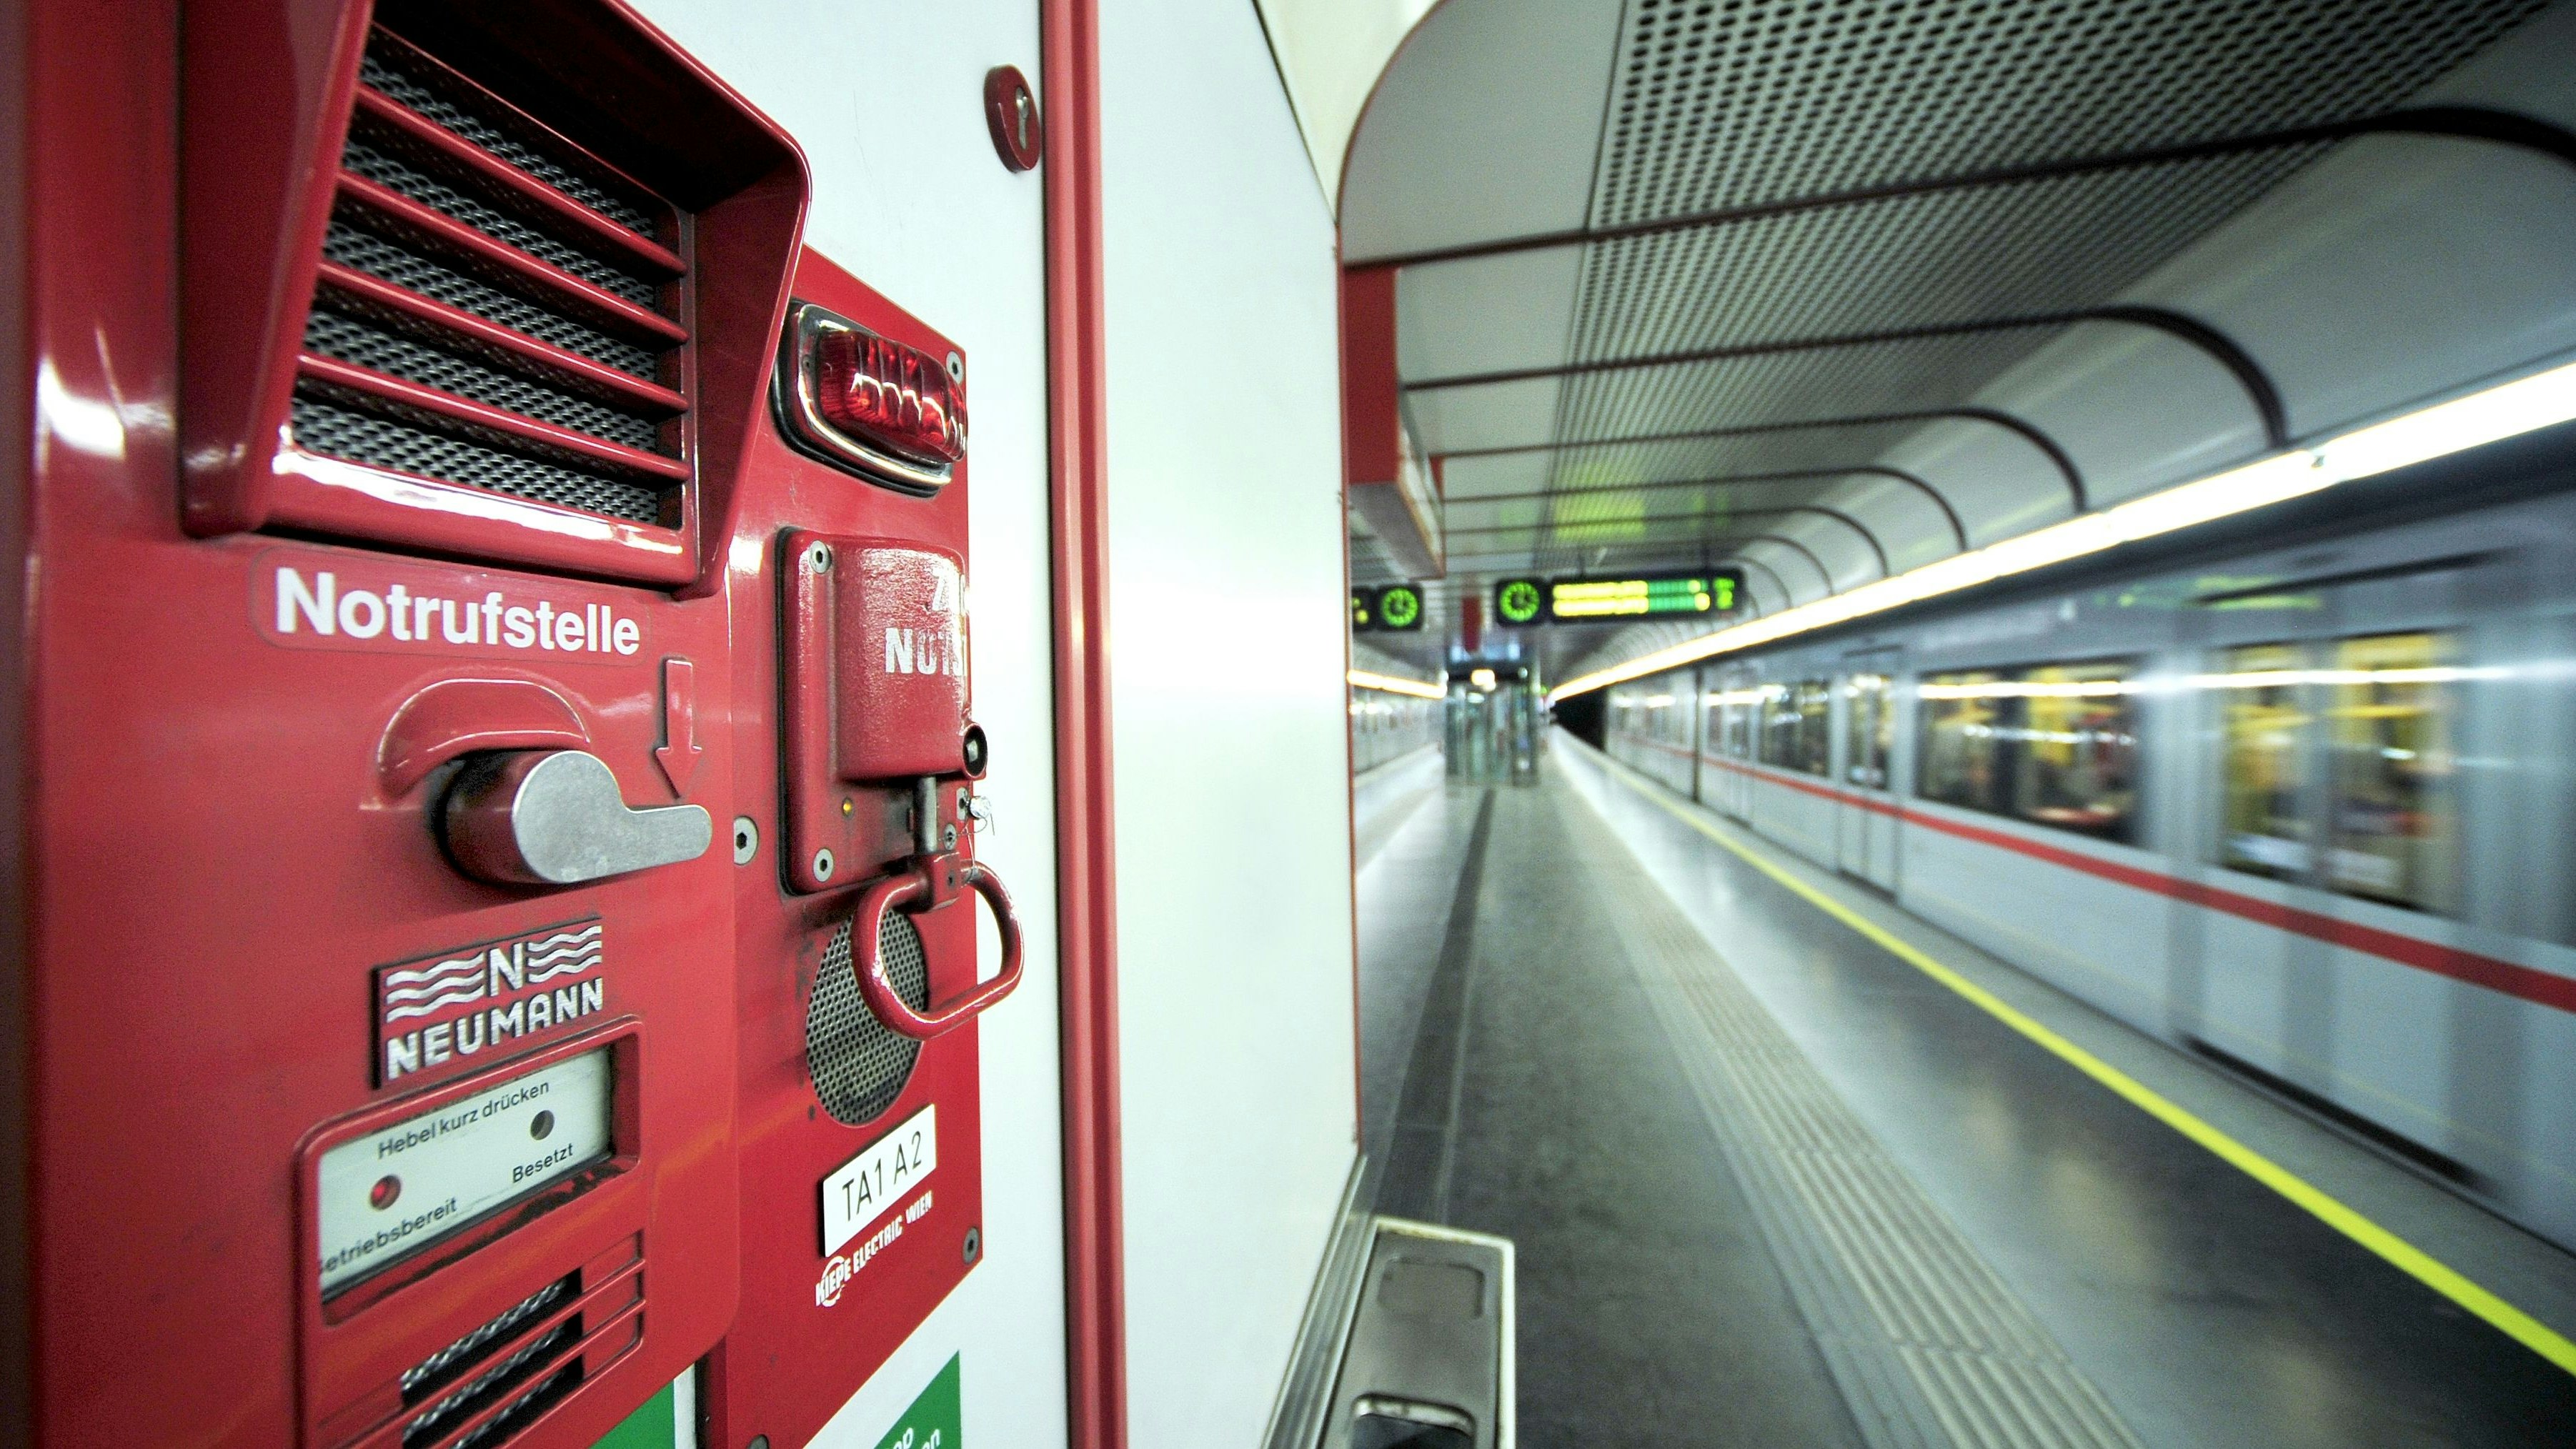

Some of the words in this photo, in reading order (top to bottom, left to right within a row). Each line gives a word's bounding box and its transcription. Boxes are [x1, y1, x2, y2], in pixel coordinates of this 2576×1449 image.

[276, 567, 640, 656] Notrufstelle
[489, 942, 524, 997] N
[387, 977, 603, 1081] NEUMANN
[377, 1123, 437, 1160] Hebel
[439, 1108, 479, 1134] kurz
[482, 1080, 550, 1118] drücken
[512, 1143, 574, 1183] Besetzt
[842, 1157, 882, 1222] TA1
[893, 1130, 922, 1185] A2
[319, 1197, 457, 1275] etriebsbereit
[815, 1257, 852, 1307] KIEPE
[852, 1215, 903, 1275] ELECTRIC
[905, 1190, 933, 1224] WIEN
